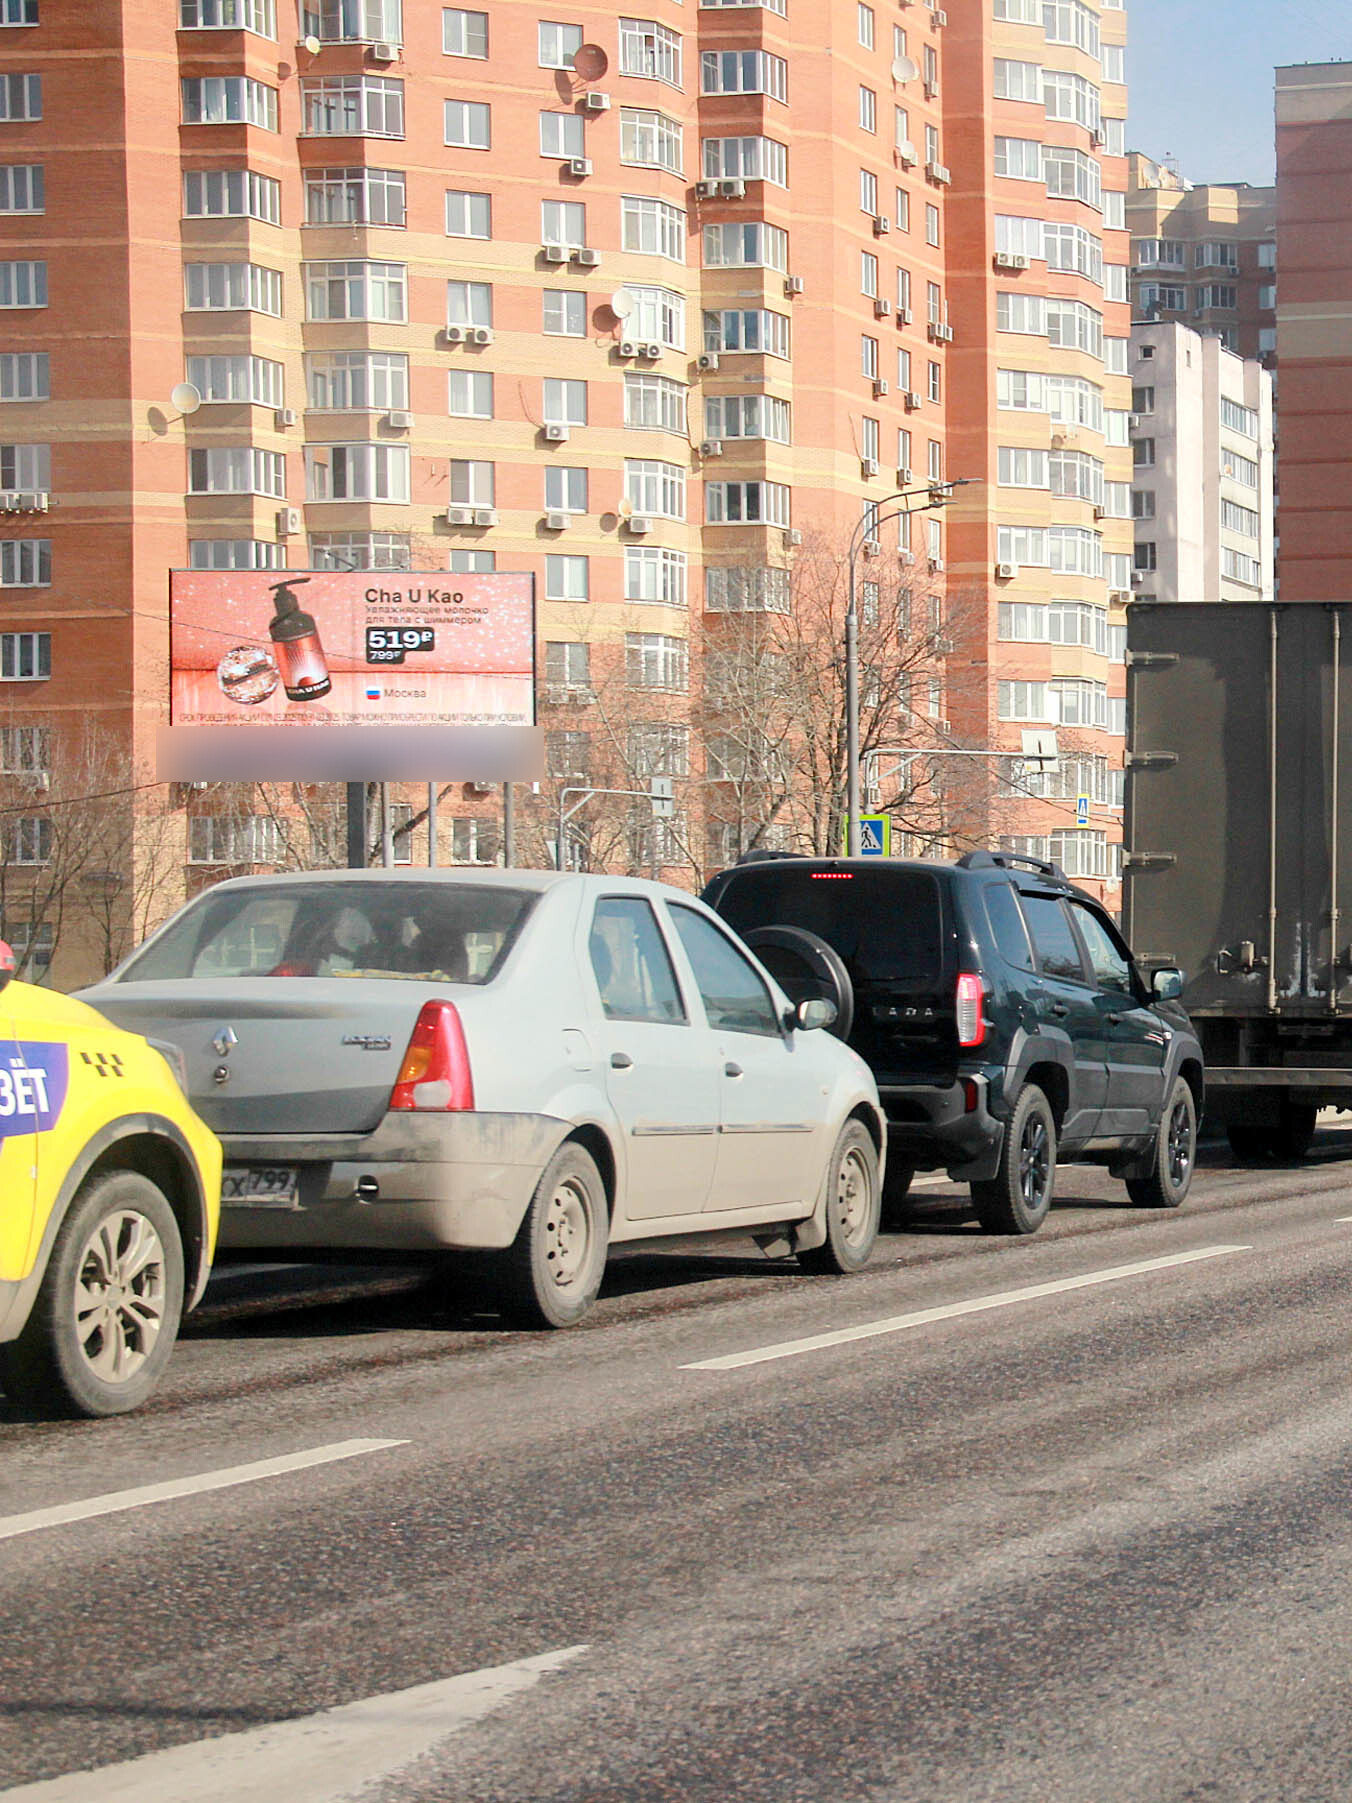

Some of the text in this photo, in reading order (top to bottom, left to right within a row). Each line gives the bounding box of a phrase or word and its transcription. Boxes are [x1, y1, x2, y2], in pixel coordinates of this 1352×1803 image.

[365, 588, 464, 603] Cha U Kao
[365, 605, 489, 615] Увлажняющее молочко
[365, 616, 482, 625] для тела с шиммером
[384, 688, 427, 698] Москва
[250, 1170, 290, 1191] 799
